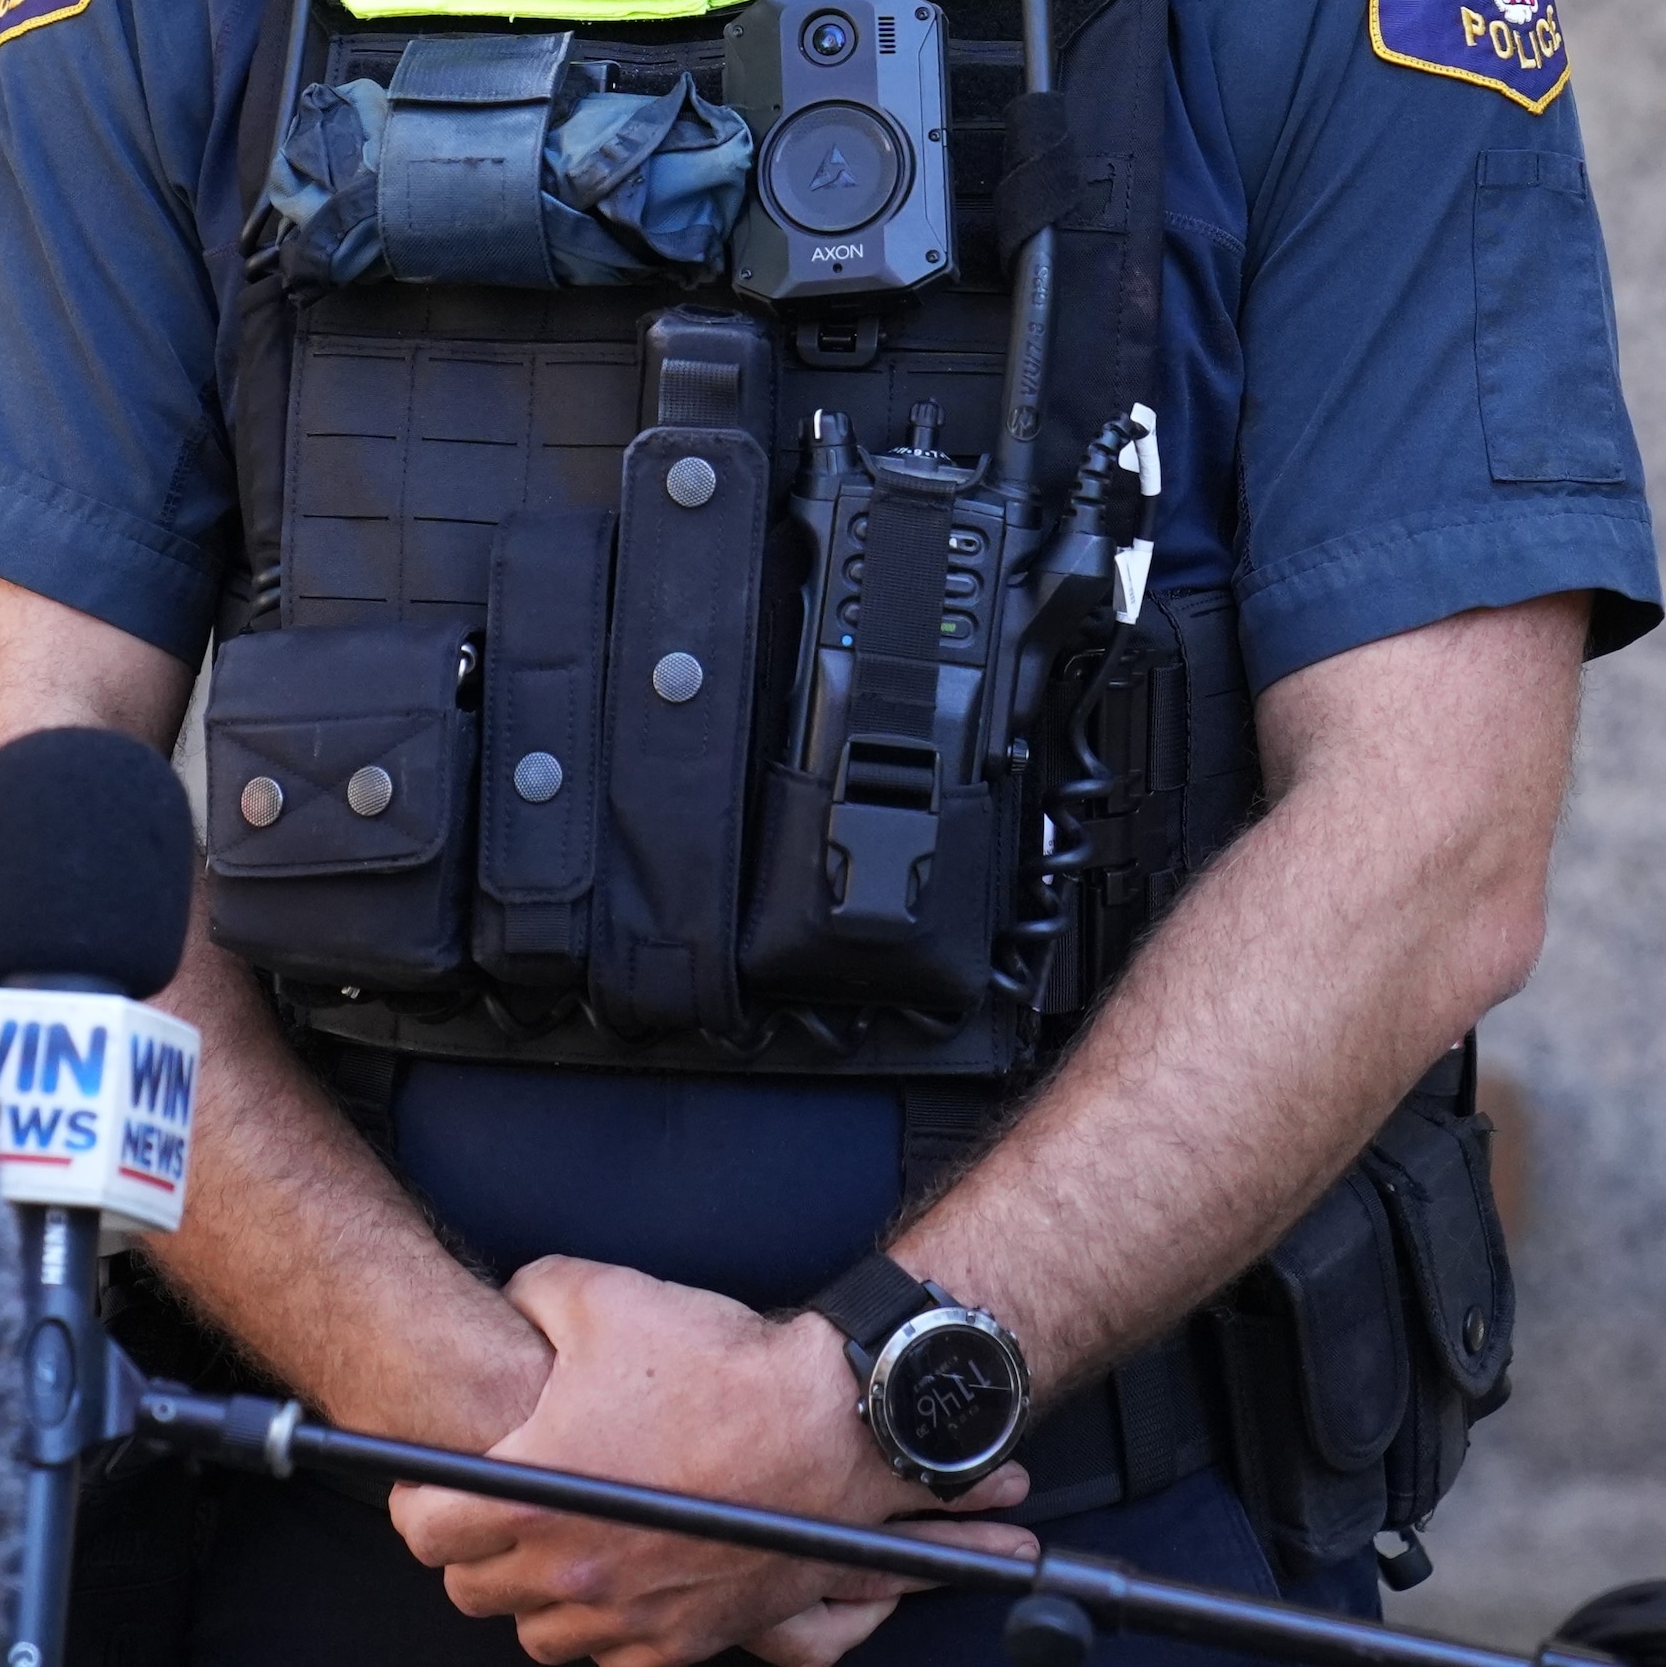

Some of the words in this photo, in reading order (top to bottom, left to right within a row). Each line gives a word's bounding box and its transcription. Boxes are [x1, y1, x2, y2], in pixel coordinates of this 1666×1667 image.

[1460, 4, 1562, 69] POLICE
[811, 243, 863, 263] AXON
[130, 1031, 194, 1129] WIN
[120, 1117, 185, 1180] NEWS
